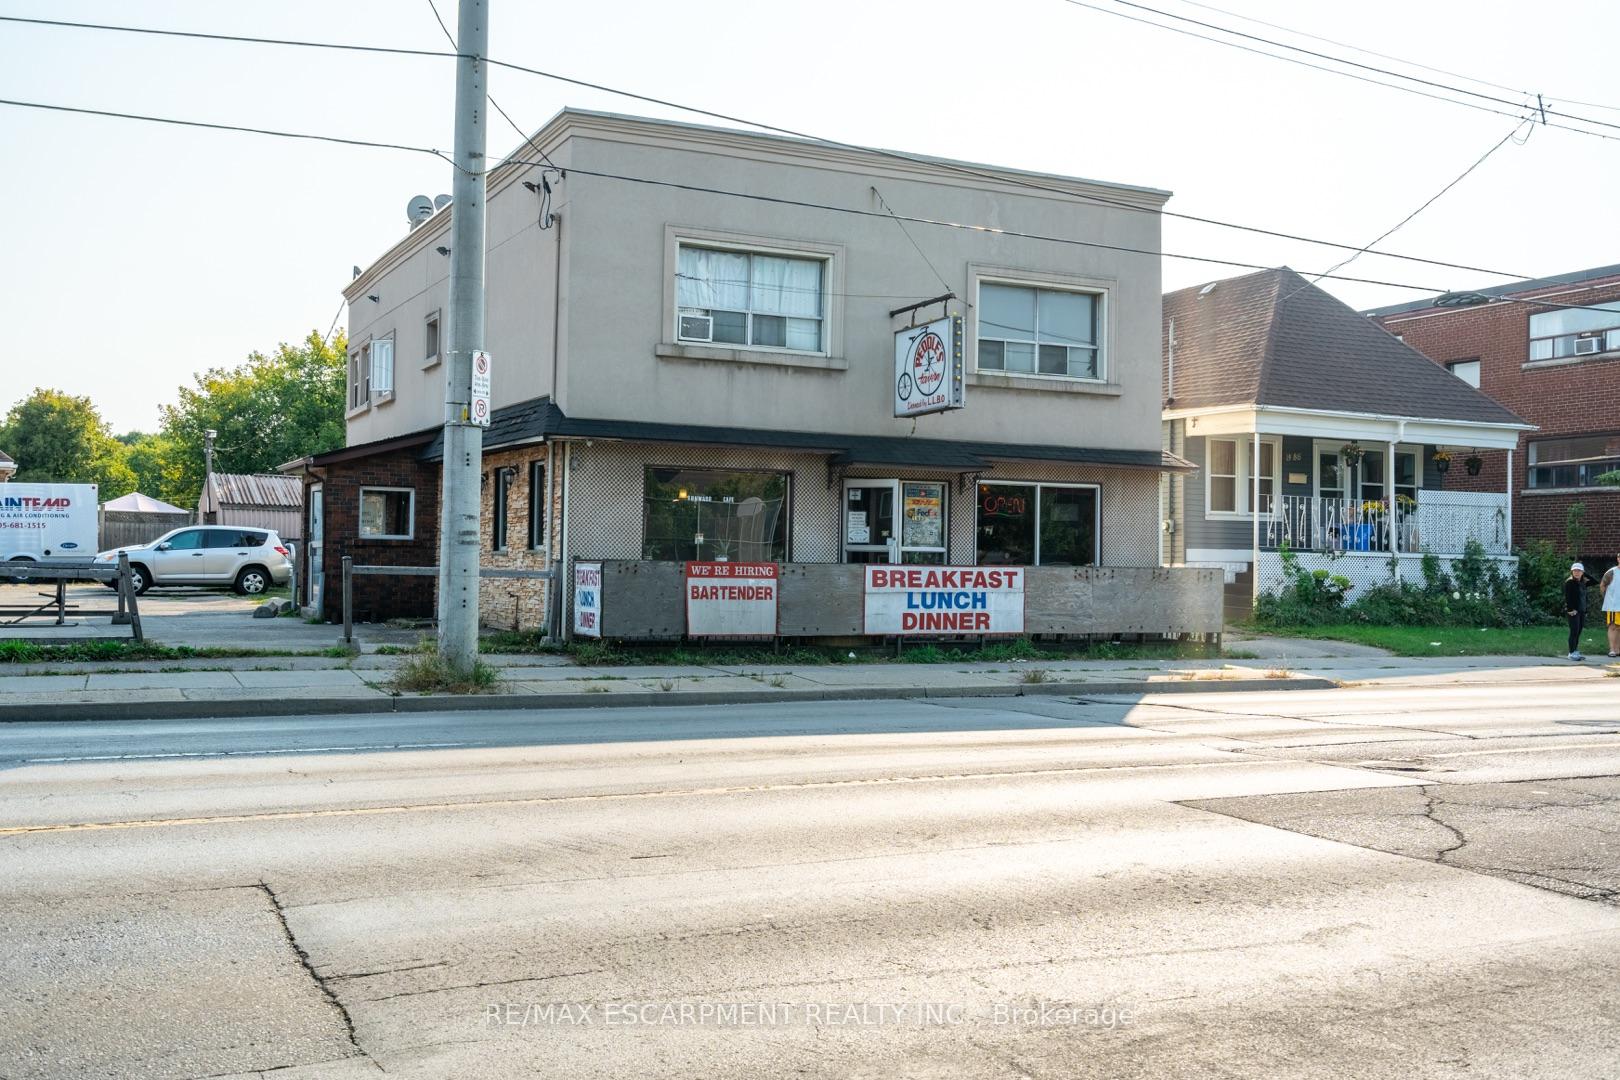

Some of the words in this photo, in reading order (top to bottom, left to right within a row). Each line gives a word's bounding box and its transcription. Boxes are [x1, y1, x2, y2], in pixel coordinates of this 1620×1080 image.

[984, 496, 1025, 513] OPEN
[734, 566, 774, 577] HIRING
[871, 569, 1018, 589] BREAKFAST
[690, 585, 773, 601] BARTENDER
[906, 591, 987, 610] LUNCH
[902, 612, 991, 631] DINNER
